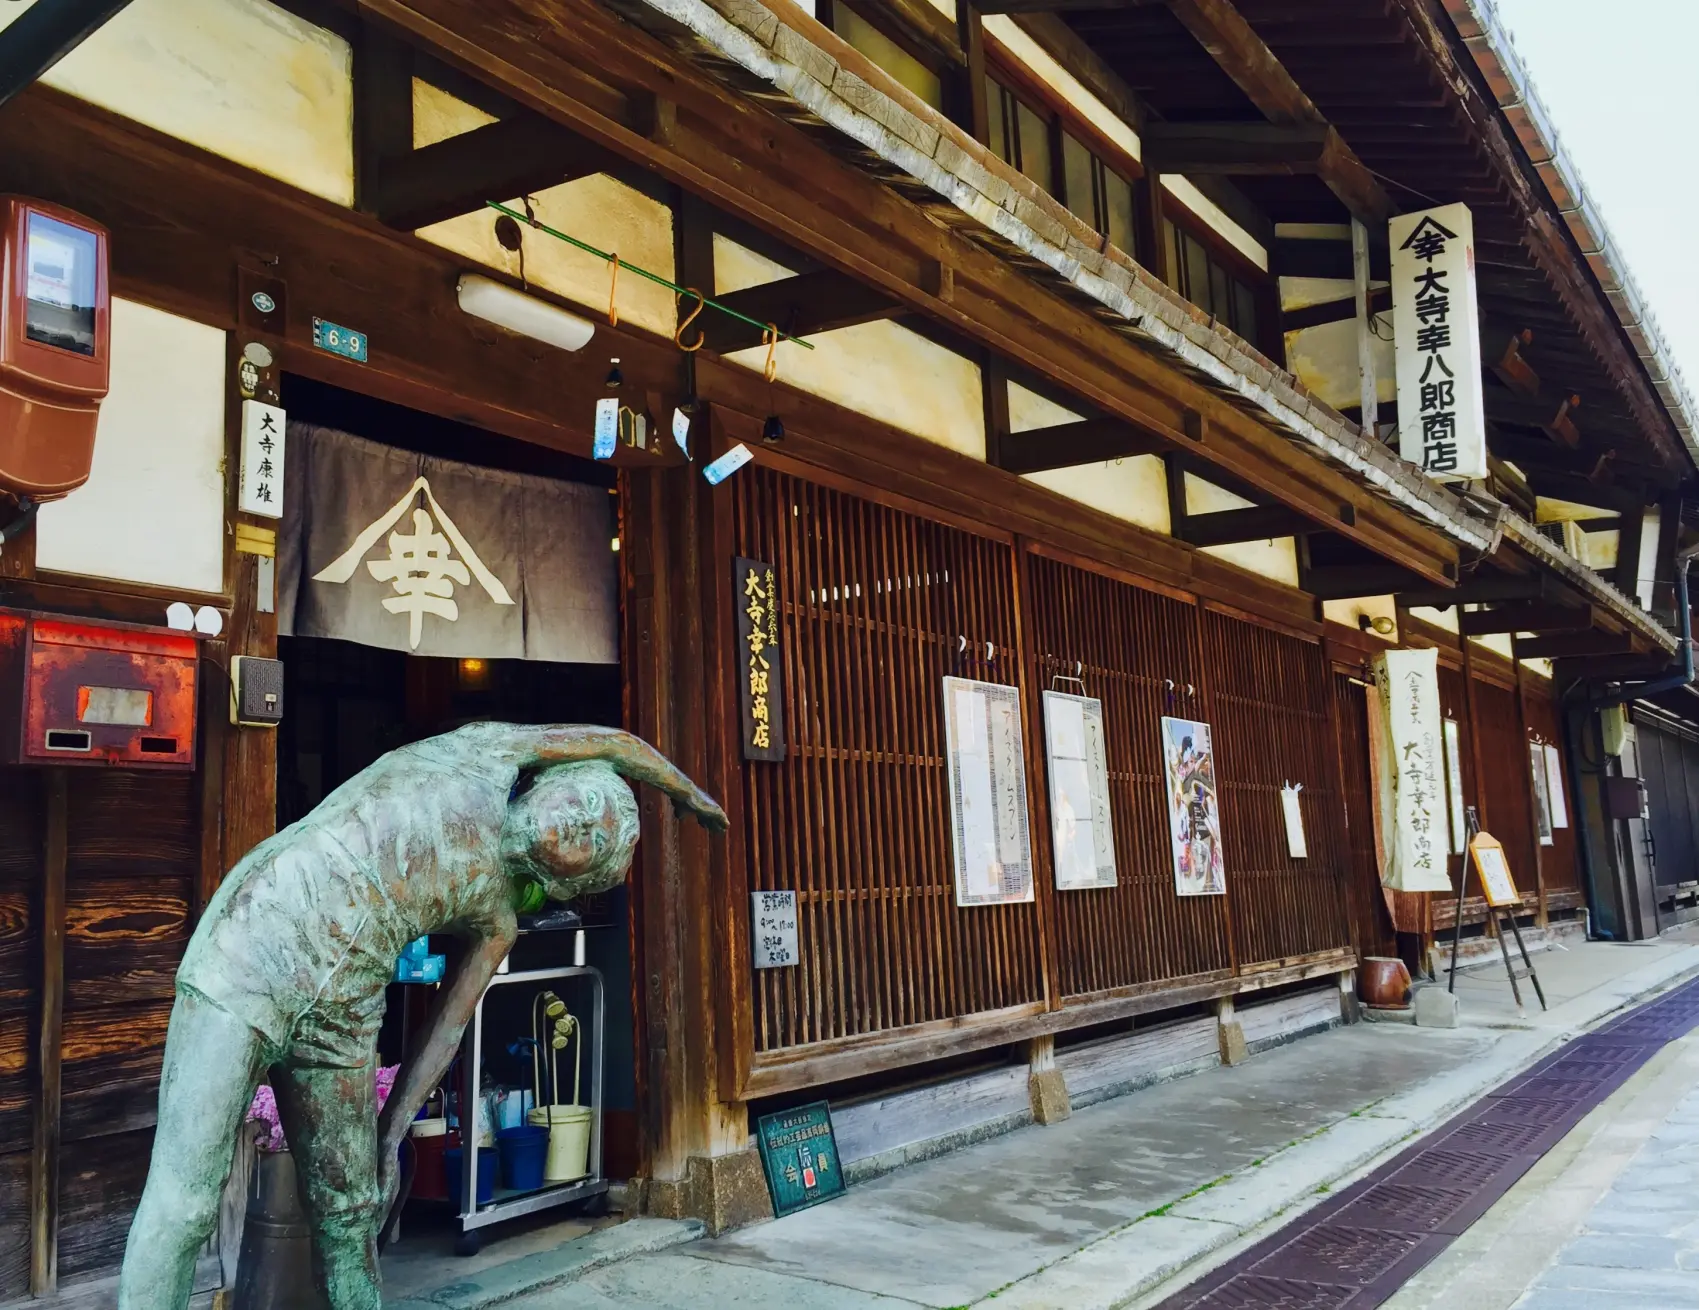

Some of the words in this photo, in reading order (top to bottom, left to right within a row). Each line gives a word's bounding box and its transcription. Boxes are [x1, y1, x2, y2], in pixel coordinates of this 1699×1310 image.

[329, 329, 360, 353] 6-9
[1413, 266, 1458, 473] 大寺幸八郎商店
[256, 411, 278, 503] 大寺康雄
[744, 568, 771, 749] 大寺幸八郎商店
